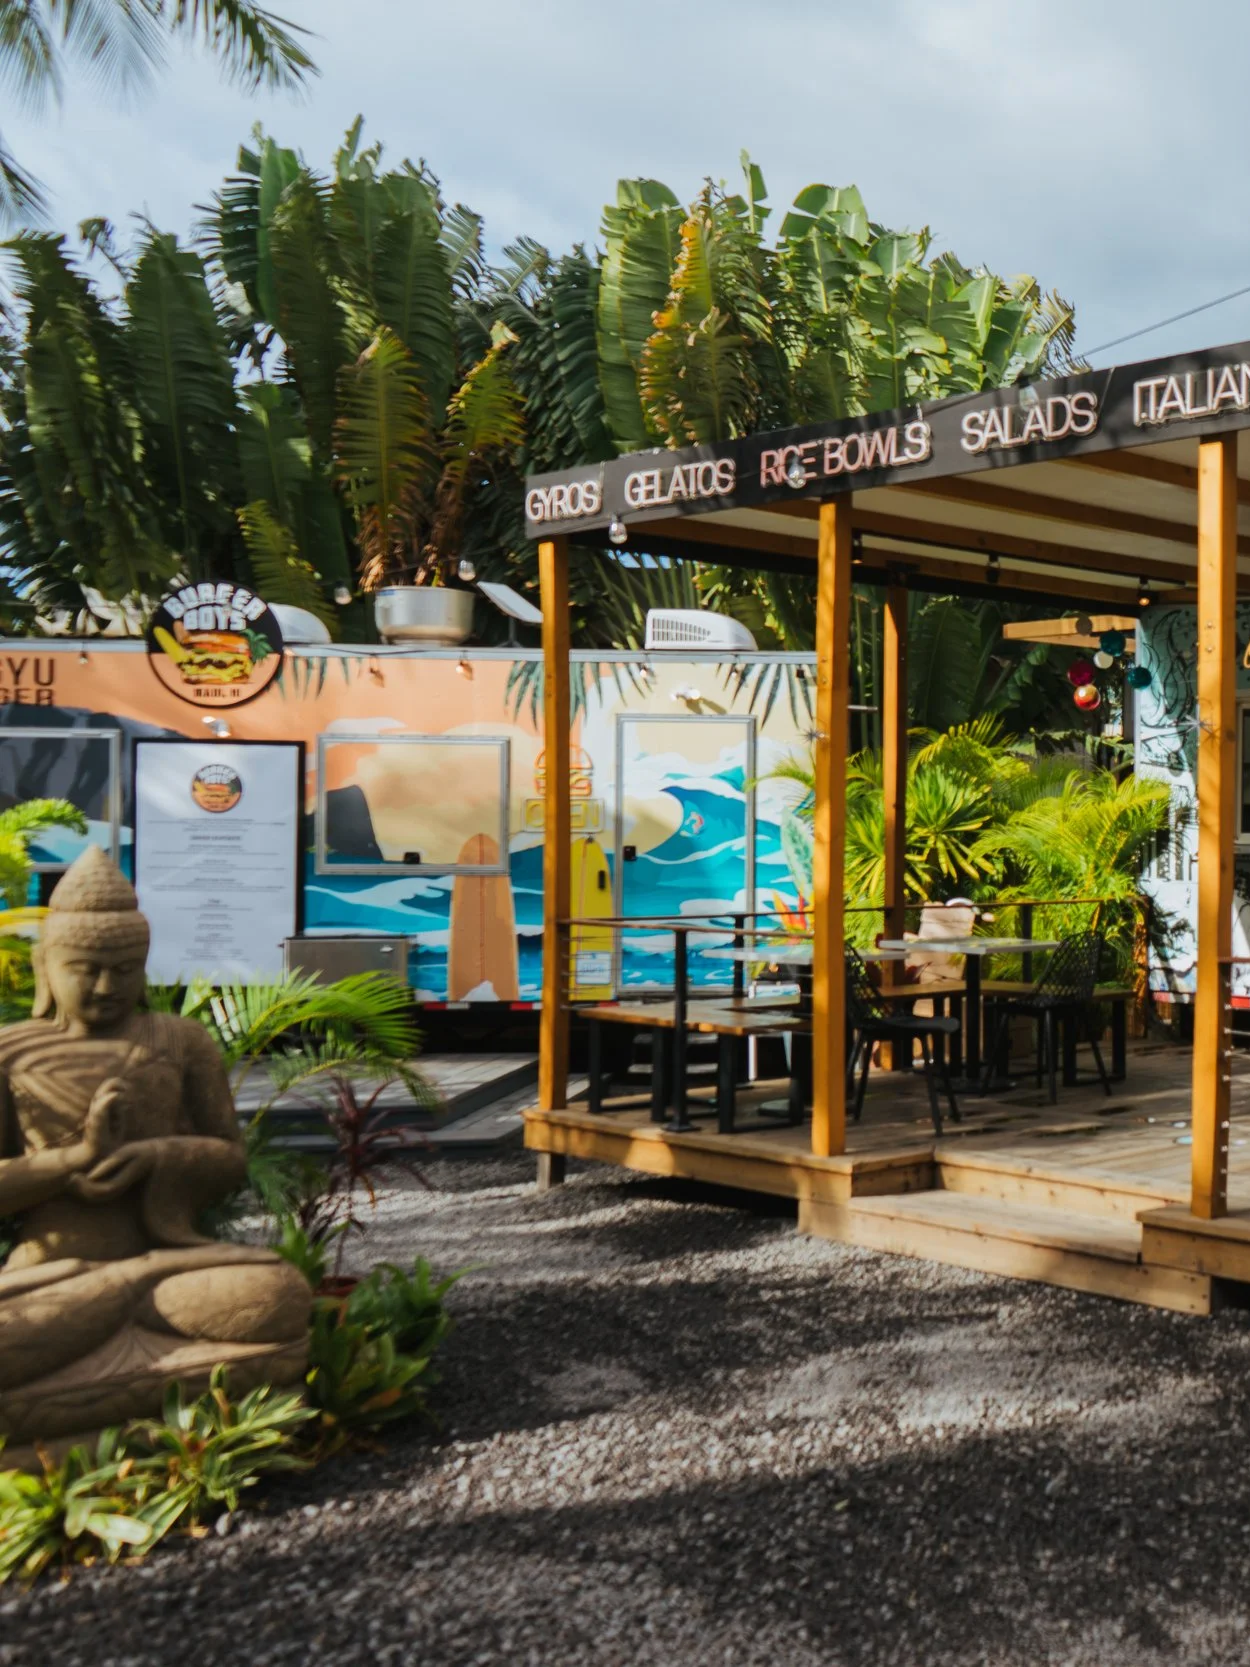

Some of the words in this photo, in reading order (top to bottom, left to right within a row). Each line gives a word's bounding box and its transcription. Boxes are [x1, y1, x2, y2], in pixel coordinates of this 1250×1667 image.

[960, 391, 1098, 454] SALADS
[760, 441, 818, 488] RICE
[823, 420, 931, 475] BOWLS
[525, 480, 601, 522] GYROS
[624, 458, 736, 507] GELATOS
[163, 583, 267, 620] BURGER
[183, 605, 247, 630] BOYS
[0, 657, 55, 686] YU
[525, 801, 600, 829] OEN
